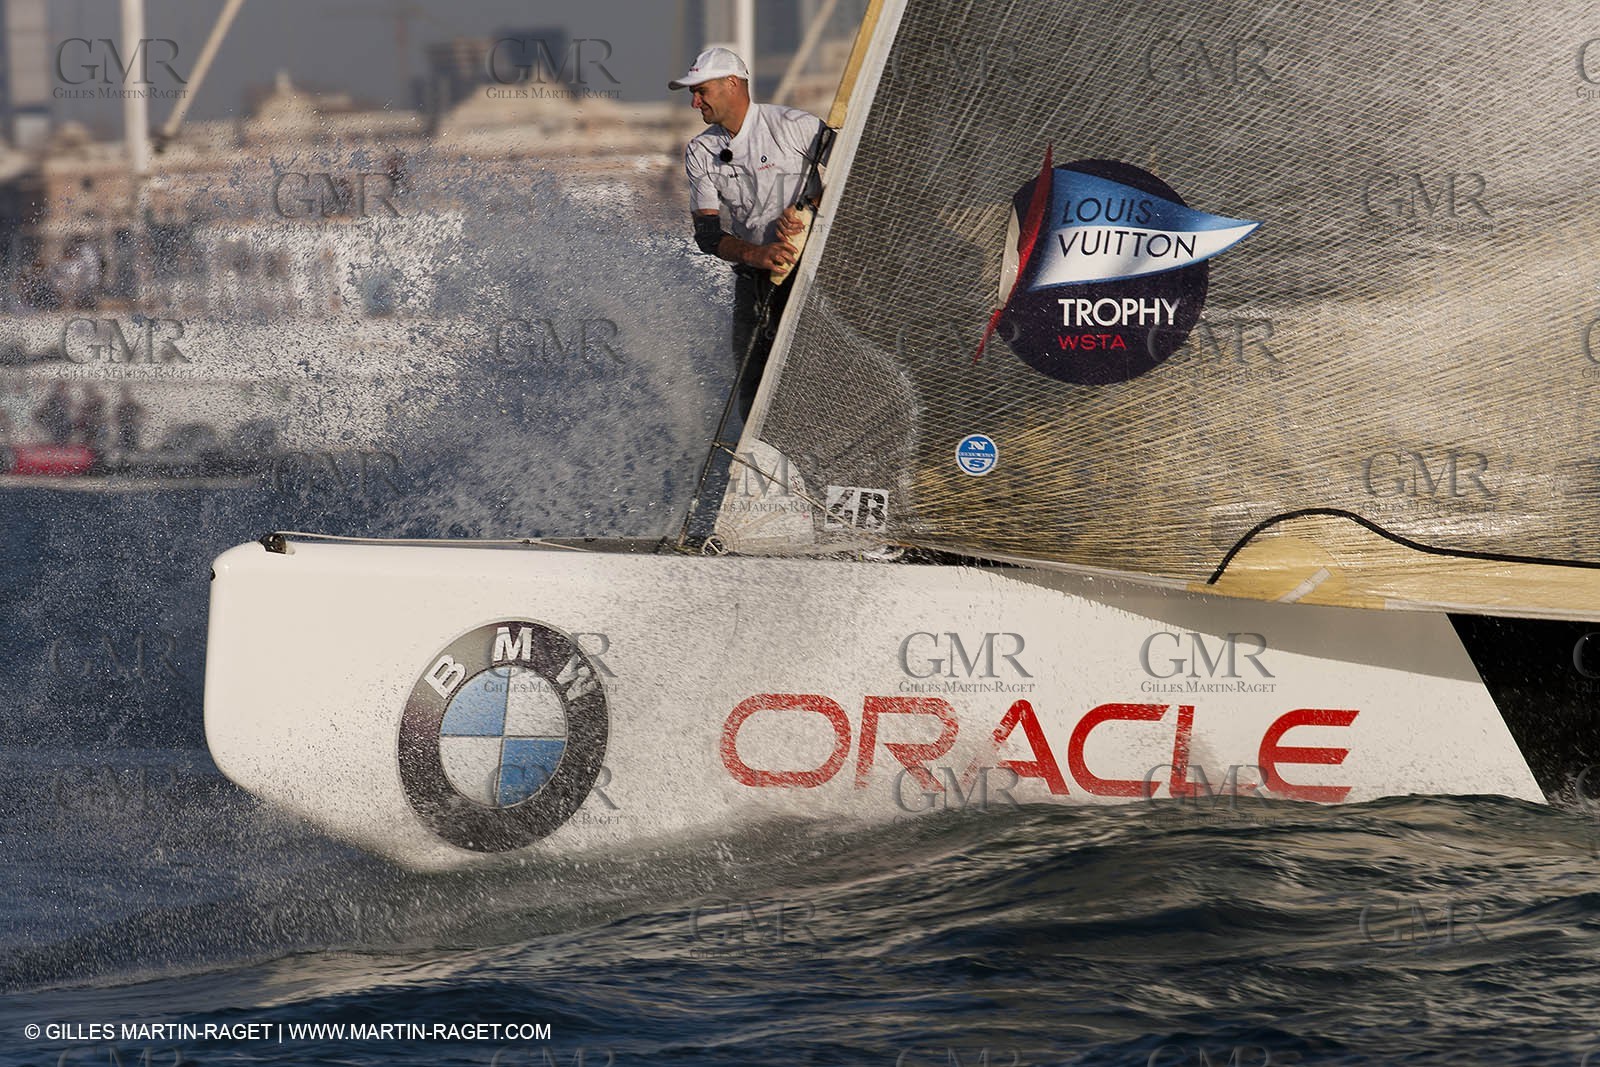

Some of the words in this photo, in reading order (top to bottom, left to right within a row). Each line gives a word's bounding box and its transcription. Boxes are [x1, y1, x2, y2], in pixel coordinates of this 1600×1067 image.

[1062, 197, 1152, 225] LOUIS
[1058, 230, 1197, 259] VUITTON
[1057, 297, 1181, 327] TROPHY
[1058, 333, 1127, 351] WSTA
[424, 626, 598, 701] BMW
[720, 693, 1359, 801] ORACLE
